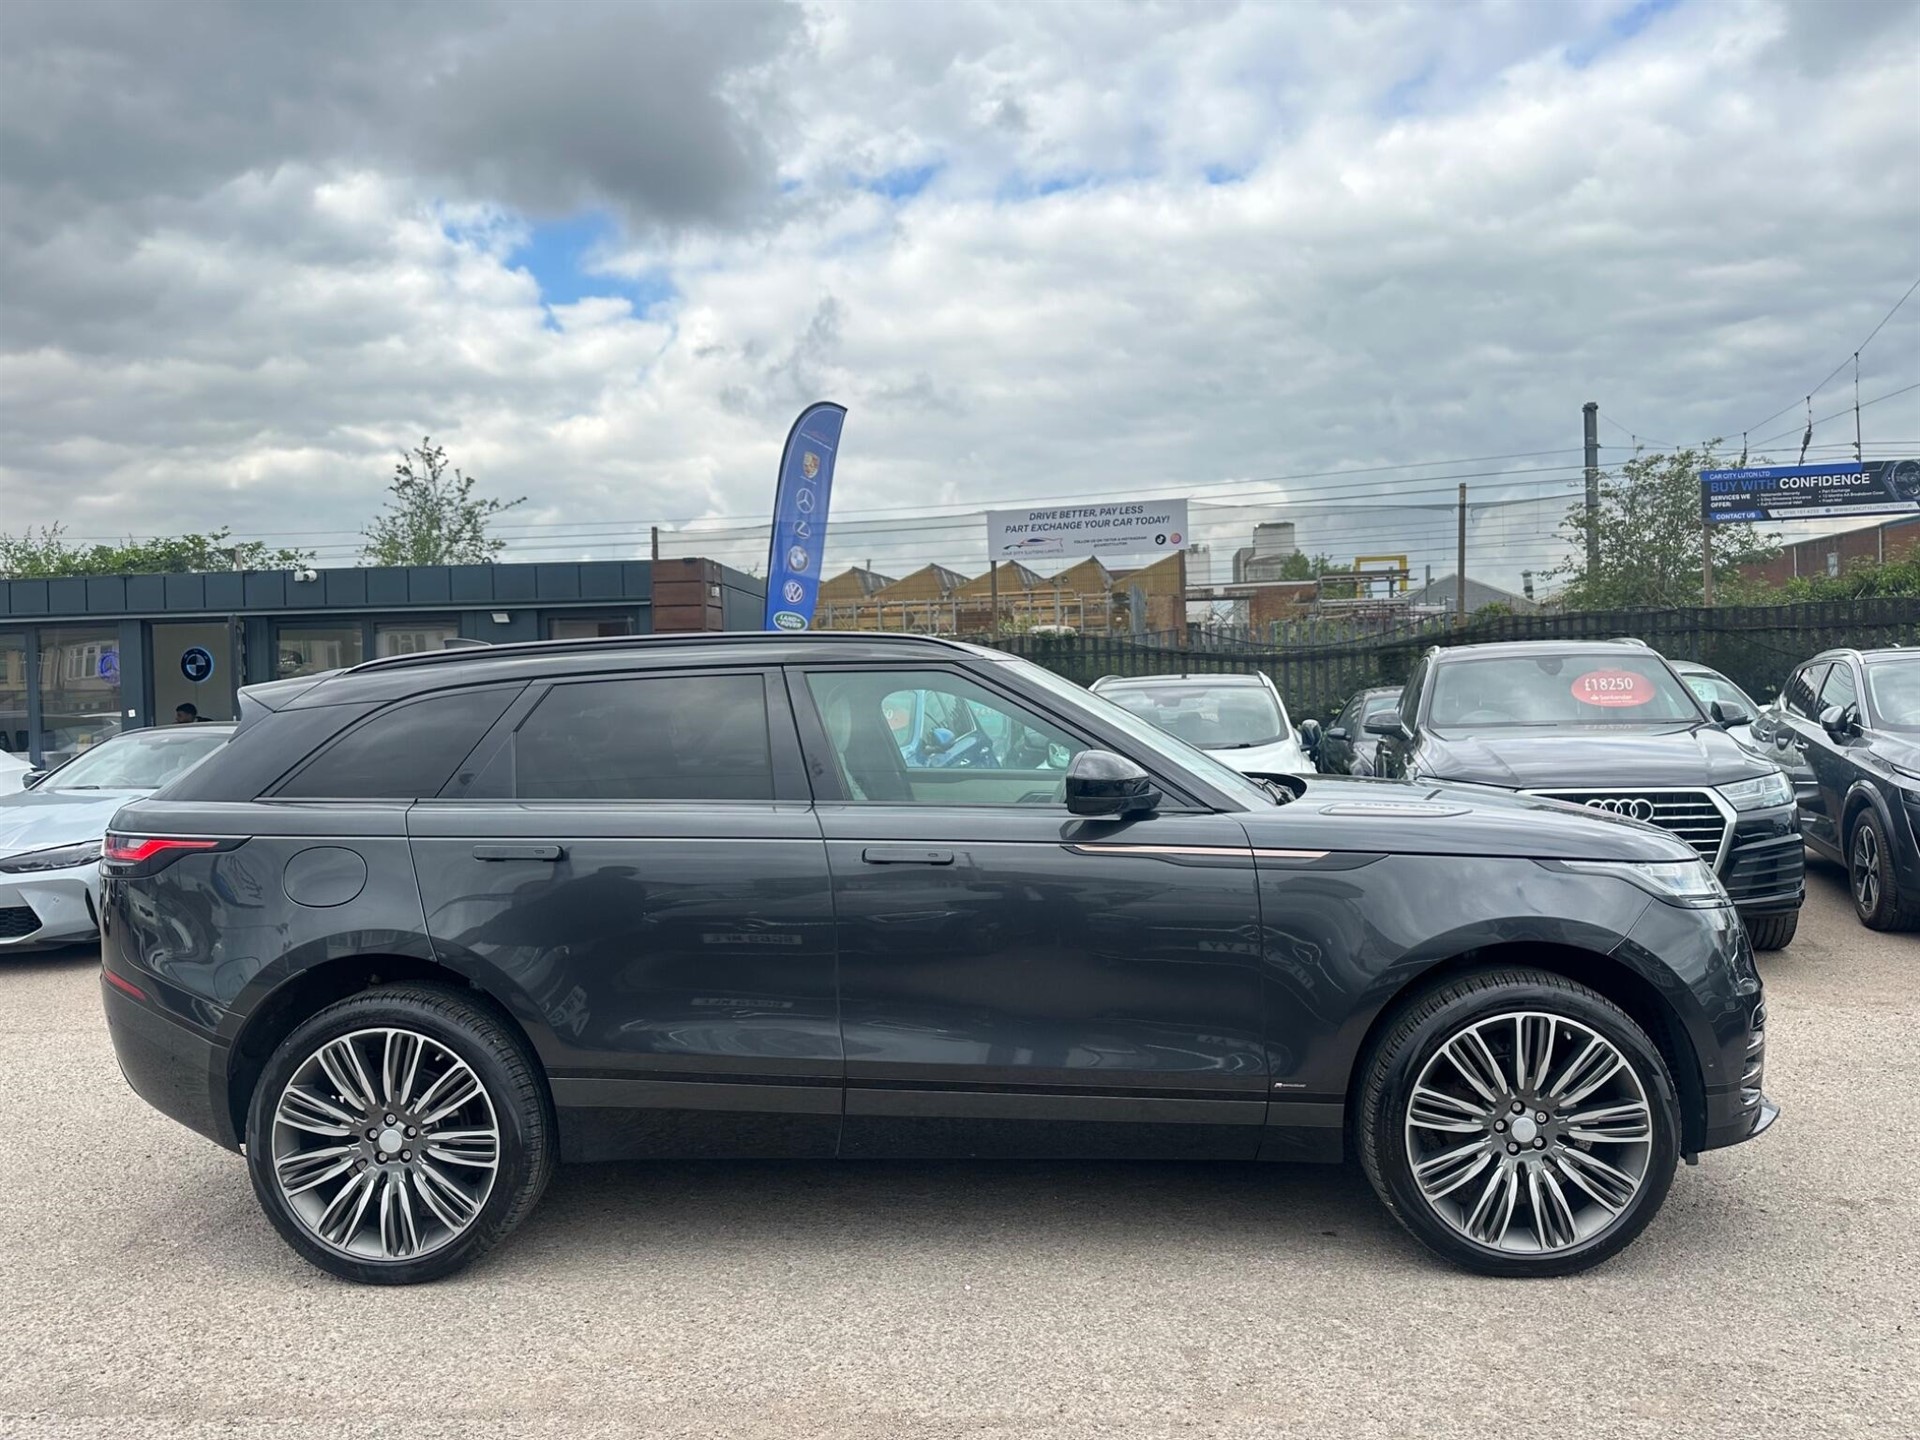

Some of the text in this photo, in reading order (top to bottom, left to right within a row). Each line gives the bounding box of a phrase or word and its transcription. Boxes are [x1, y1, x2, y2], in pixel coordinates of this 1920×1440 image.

[1711, 473, 1870, 493] BUY WITH CONFIDENCE
[1722, 472, 1737, 480] CITY
[1710, 494, 1740, 502] SERVICES
[1029, 505, 1144, 521] DRIVE BETTER, PAY LESS
[1716, 511, 1756, 520] CONTACT US
[1005, 515, 1170, 534] PART EXCHANGE YOUR CAR TODAY!
[1584, 677, 1634, 692] £18250
